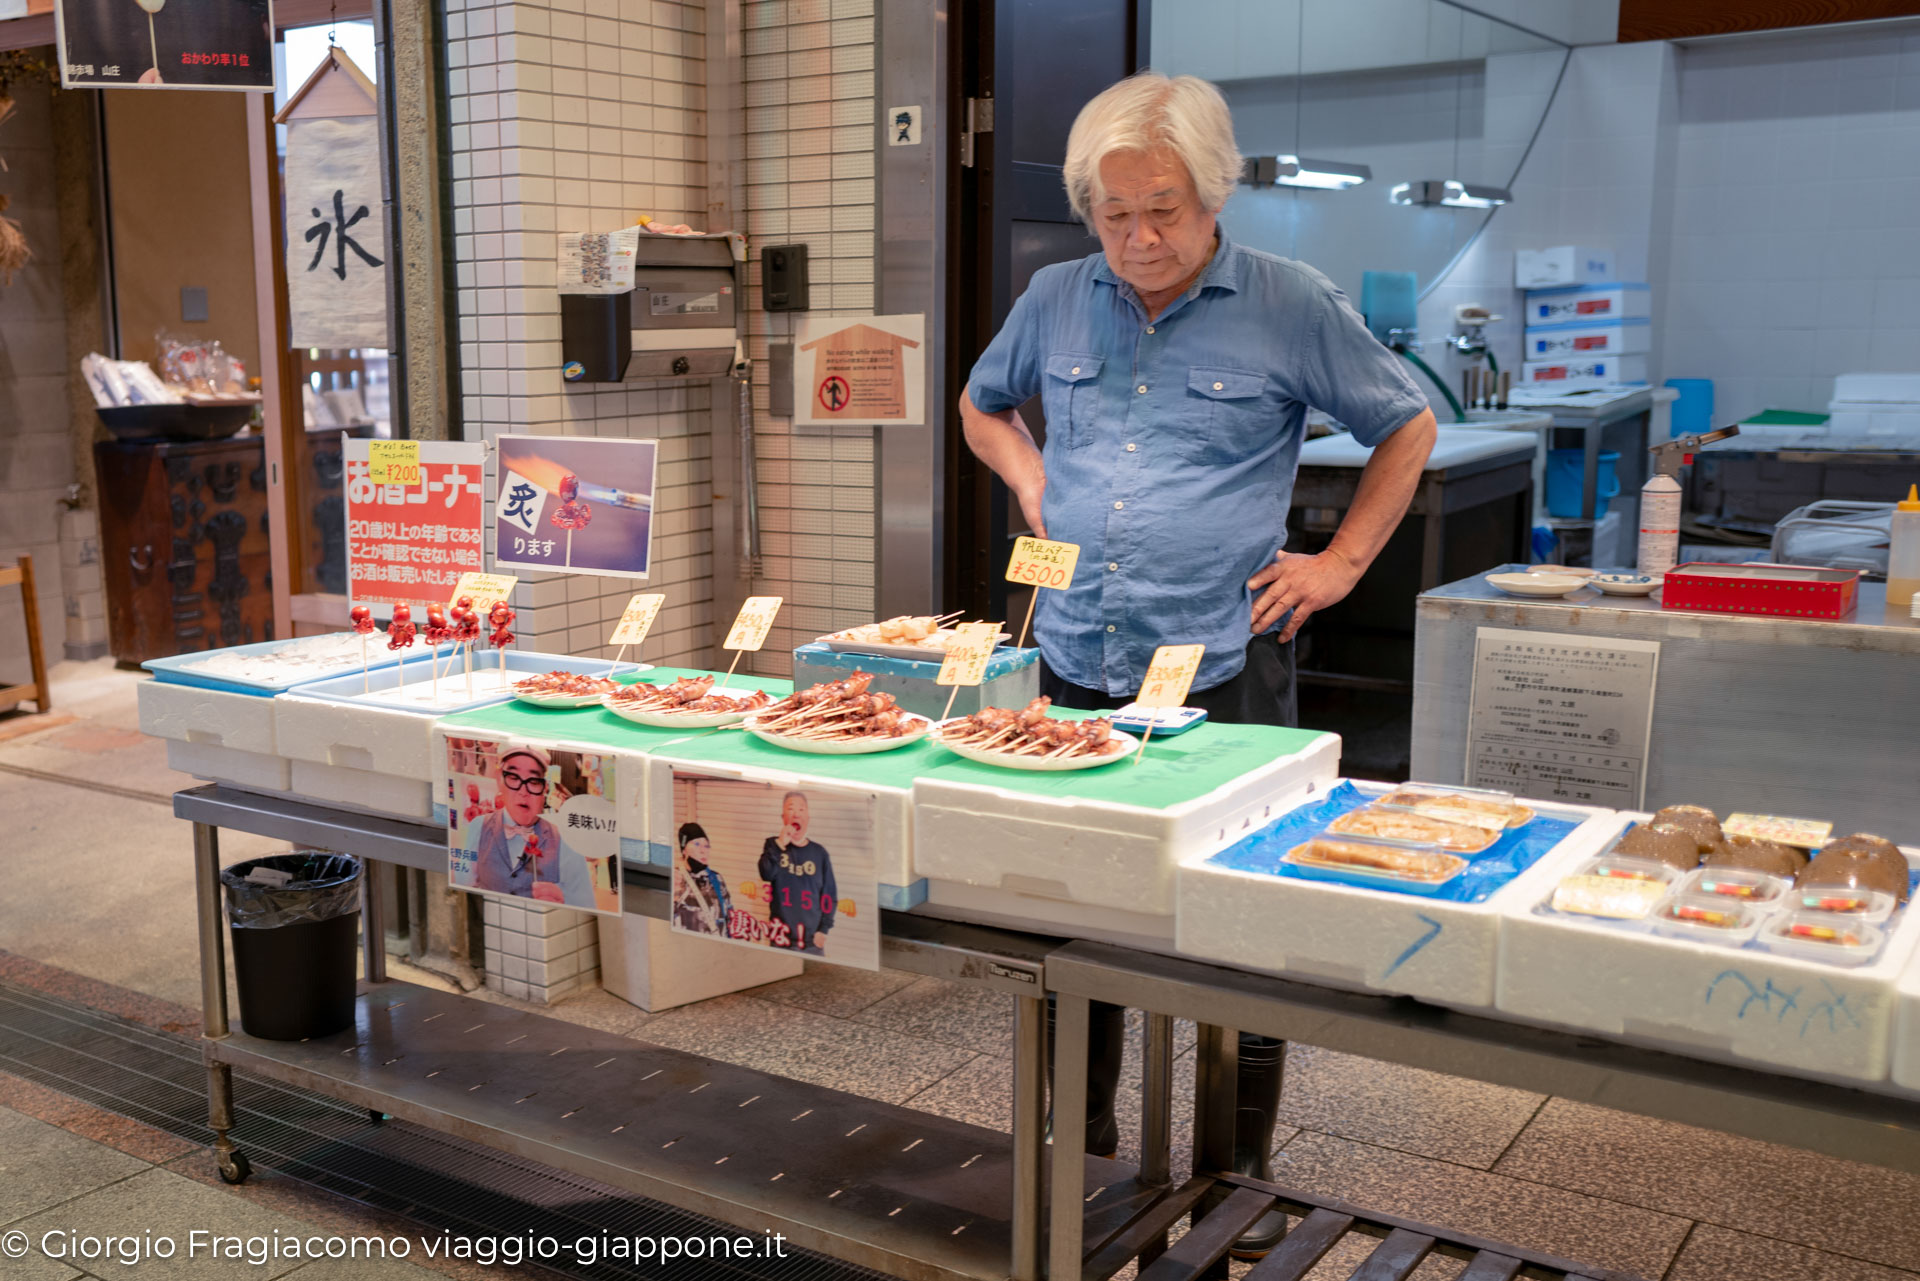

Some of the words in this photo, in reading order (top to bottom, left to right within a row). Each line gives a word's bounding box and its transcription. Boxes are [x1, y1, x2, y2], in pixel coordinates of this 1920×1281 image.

[182, 52, 250, 67] おかわり率1位
[305, 189, 385, 281] 氷
[387, 463, 418, 481] ¥200
[503, 483, 537, 529] 炙
[350, 520, 481, 544] 20歳以上の年齢である
[514, 536, 556, 557] ります
[1013, 561, 1065, 586] ¥500
[568, 813, 617, 833] 美味い!!
